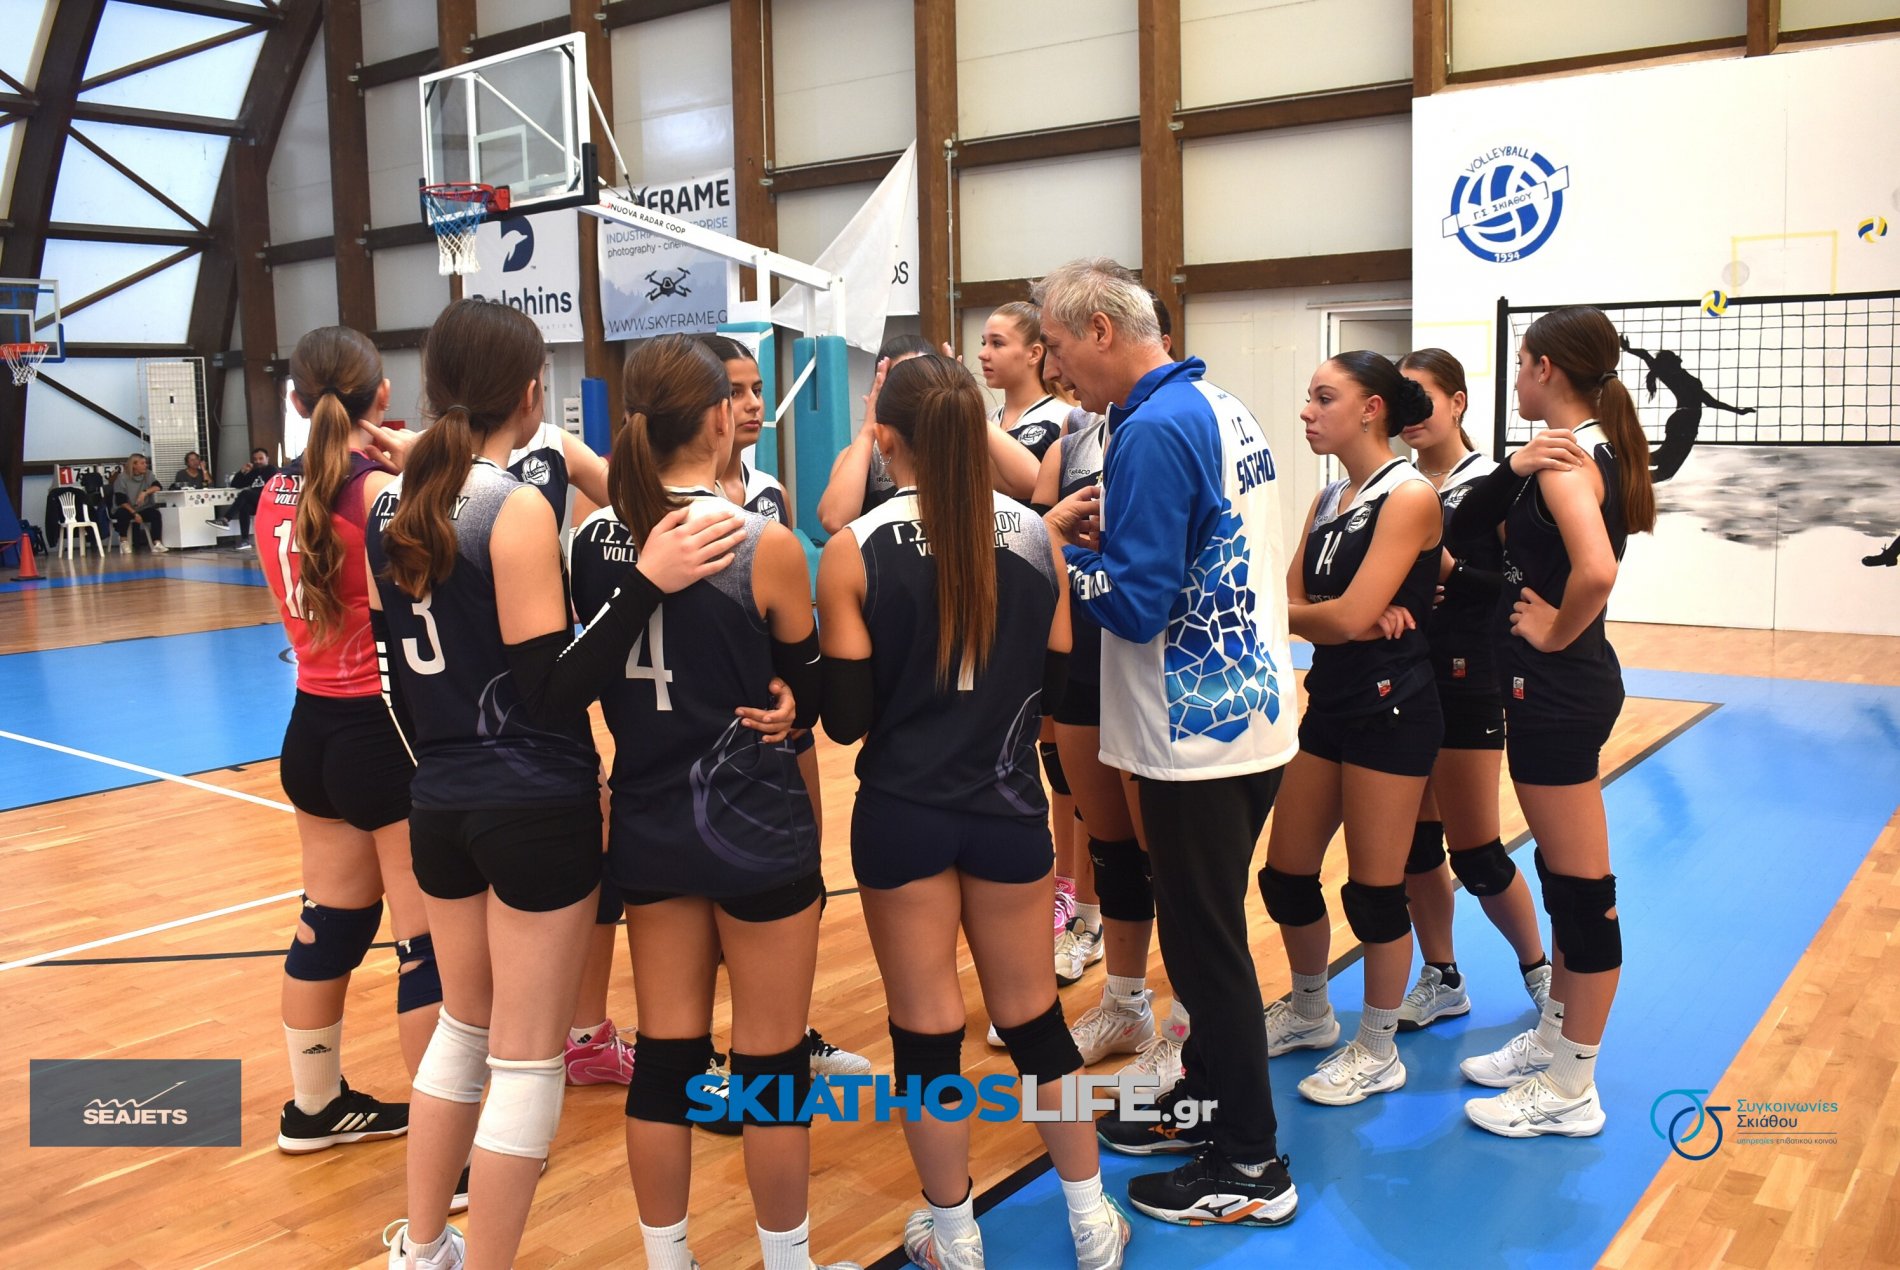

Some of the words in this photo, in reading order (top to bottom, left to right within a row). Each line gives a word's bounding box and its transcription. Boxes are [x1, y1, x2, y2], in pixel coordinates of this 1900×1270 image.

[1466, 145, 1529, 173] VOLLEYBALL
[610, 203, 638, 218] NUOVA
[639, 213, 664, 228] RADAR
[665, 222, 686, 234] COOP
[607, 242, 656, 258] photography
[1494, 251, 1520, 263] 1994
[1314, 530, 1343, 576] 14
[625, 601, 674, 711] 4
